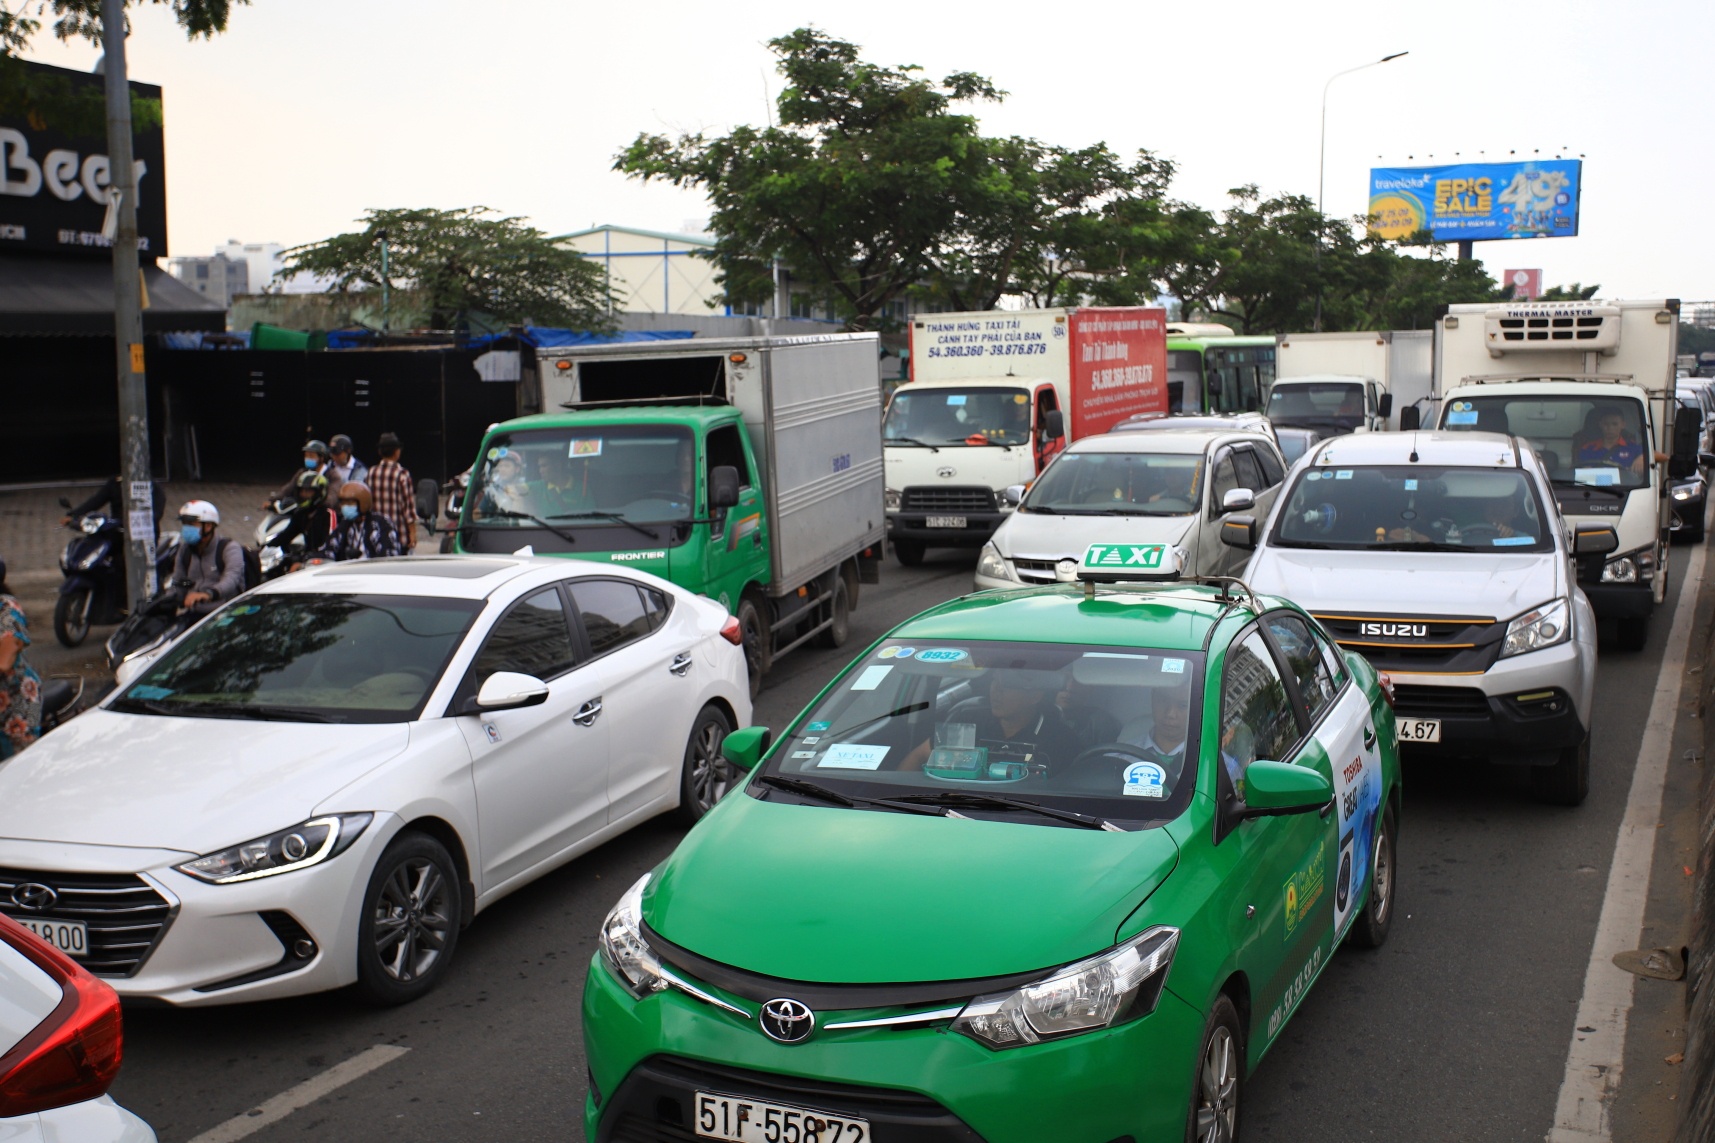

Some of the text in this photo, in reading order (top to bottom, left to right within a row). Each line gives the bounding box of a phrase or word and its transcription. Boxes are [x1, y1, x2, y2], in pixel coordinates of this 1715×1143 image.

[1375, 178, 1424, 189] traveloka
[1434, 195, 1491, 213] SALE
[1555, 309, 1593, 317] MASTER
[927, 322, 955, 333] THÀNH
[985, 320, 1004, 330] TAXI
[963, 333, 979, 343] TAY
[611, 551, 665, 561] FRONTIER
[1361, 623, 1427, 637] ISUZU
[921, 651, 961, 661] 8932
[1343, 755, 1363, 785] TOSHIBA
